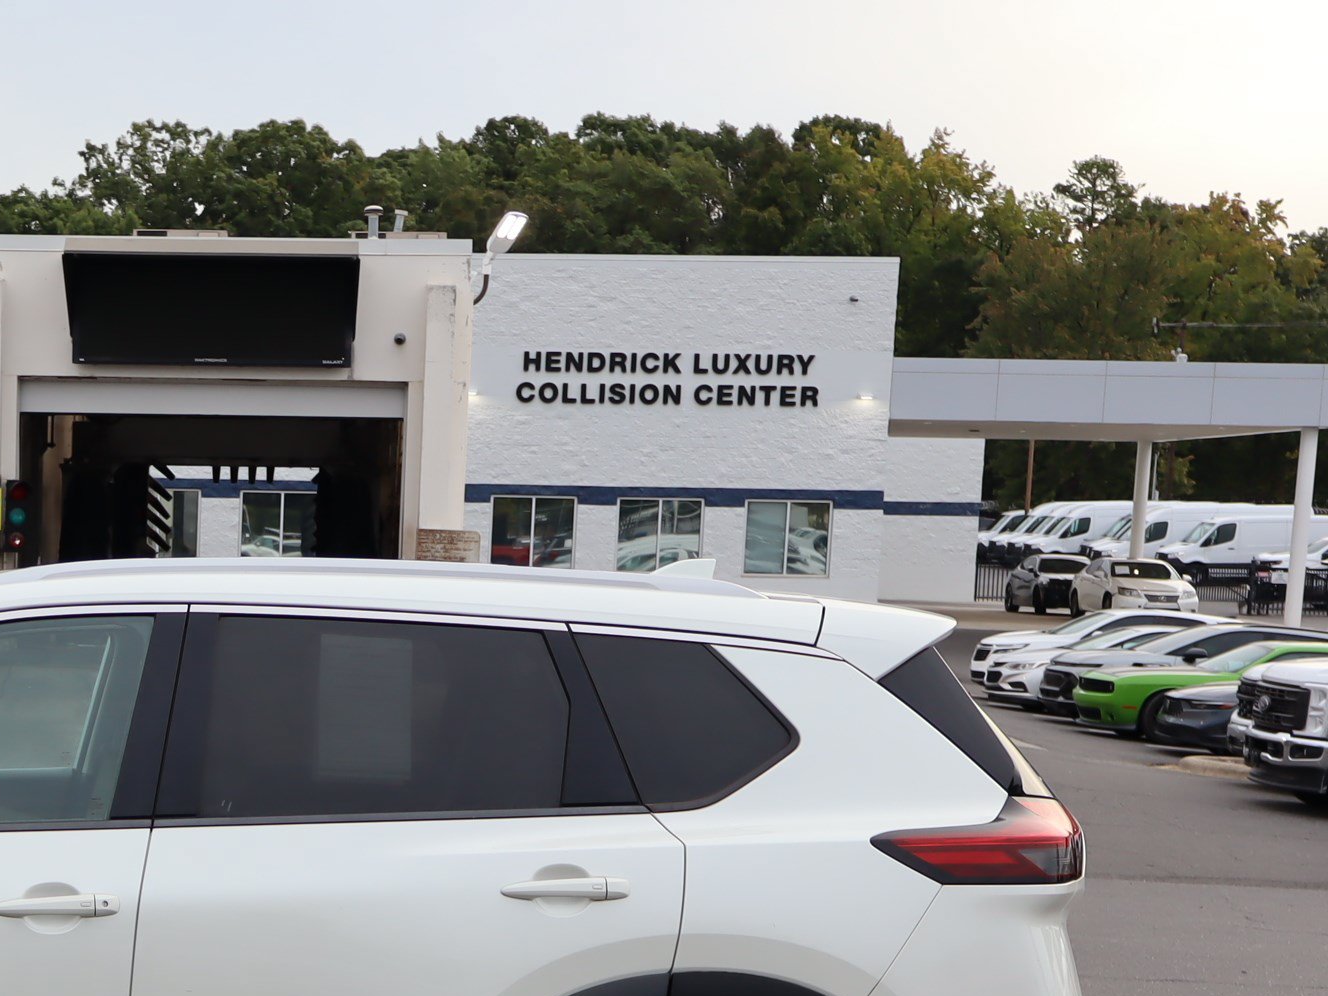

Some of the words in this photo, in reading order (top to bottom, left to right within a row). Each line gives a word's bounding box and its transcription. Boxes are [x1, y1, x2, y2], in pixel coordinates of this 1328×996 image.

[523, 351, 681, 374] HENDRICK
[693, 354, 815, 375] LUXURY
[516, 382, 681, 405] COLLISION
[694, 385, 818, 407] CENTER
